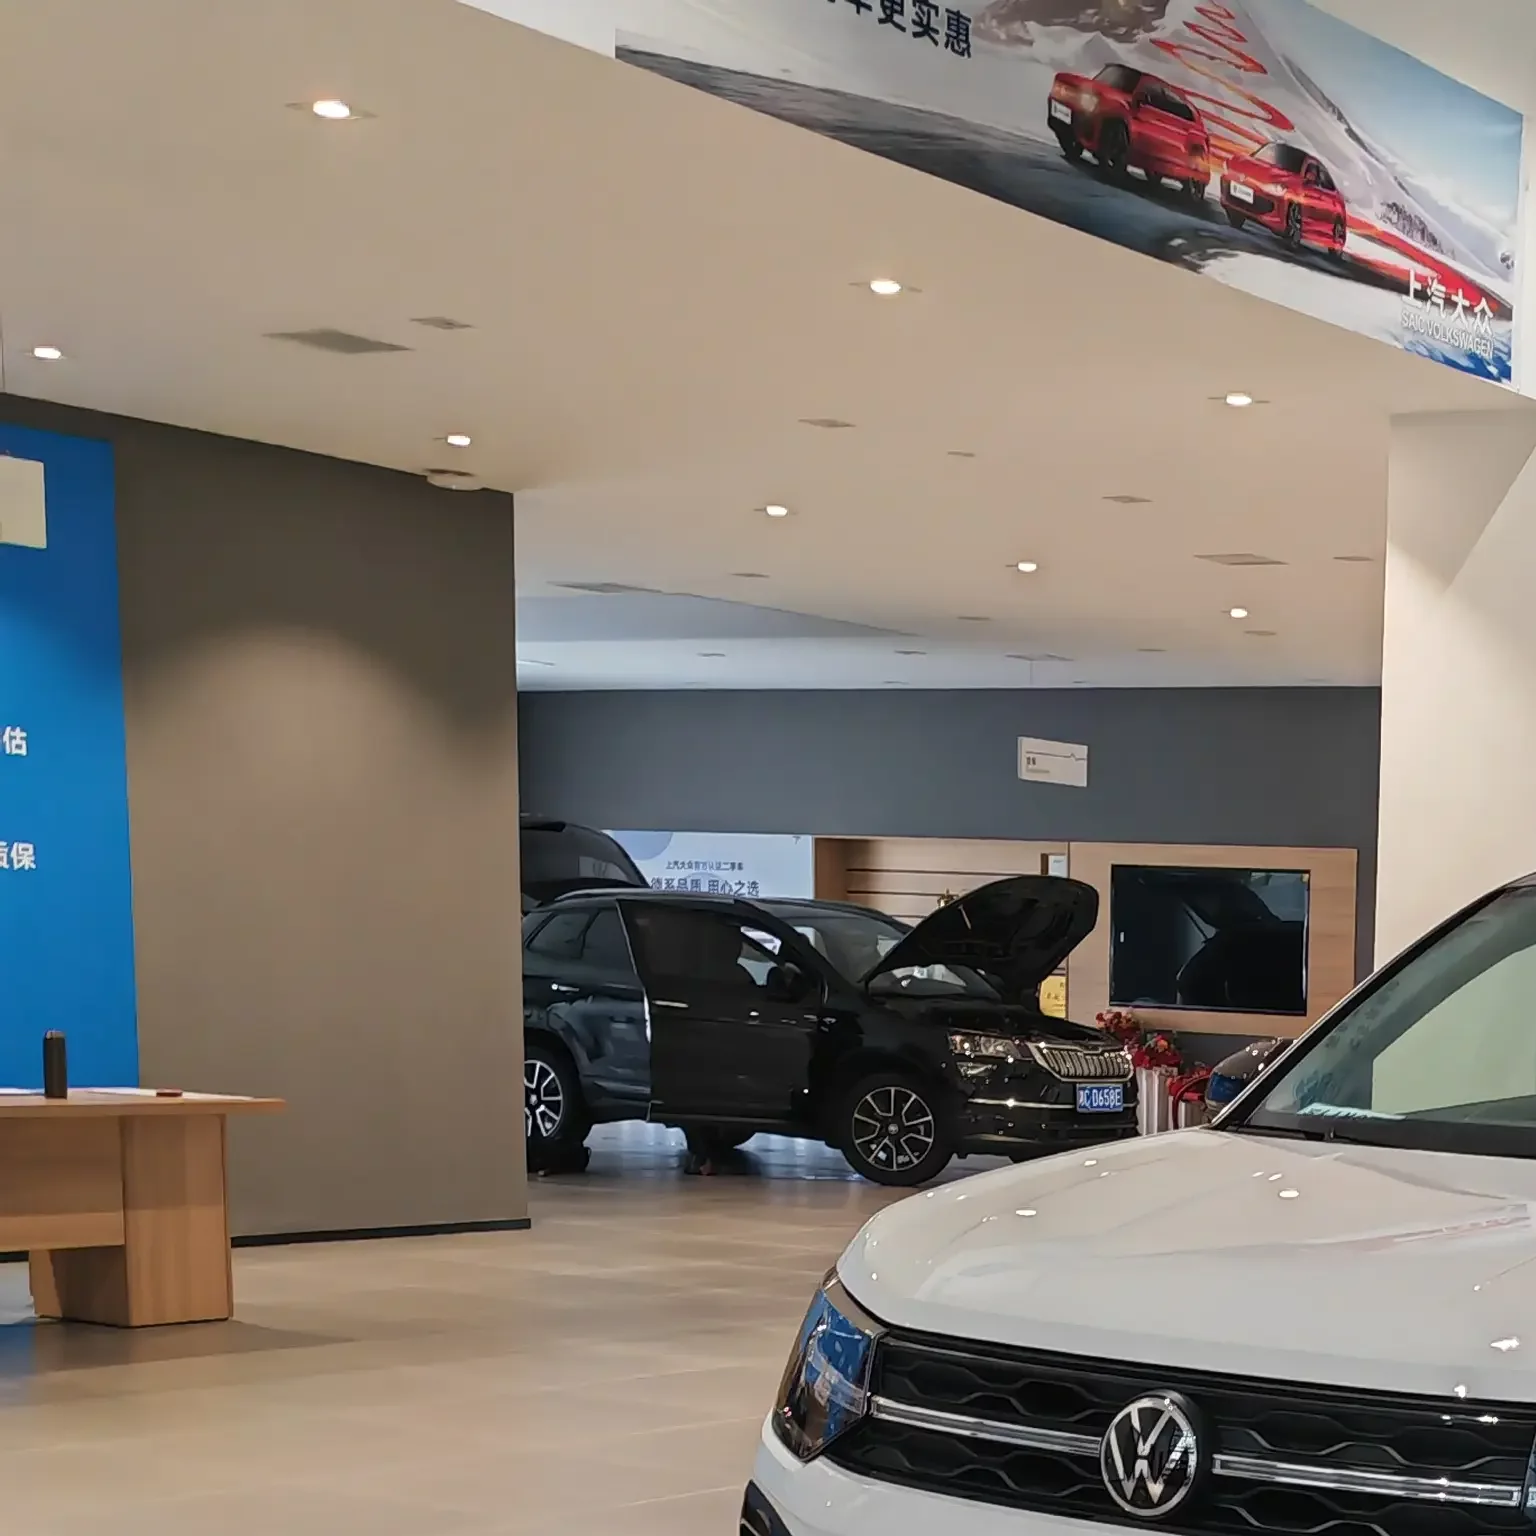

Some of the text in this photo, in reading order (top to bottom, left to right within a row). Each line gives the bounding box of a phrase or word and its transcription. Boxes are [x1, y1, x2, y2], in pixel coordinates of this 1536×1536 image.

[1402, 268, 1494, 336] 上汽大众
[1402, 311, 1495, 360] SAIC VOLKSWAGEN
